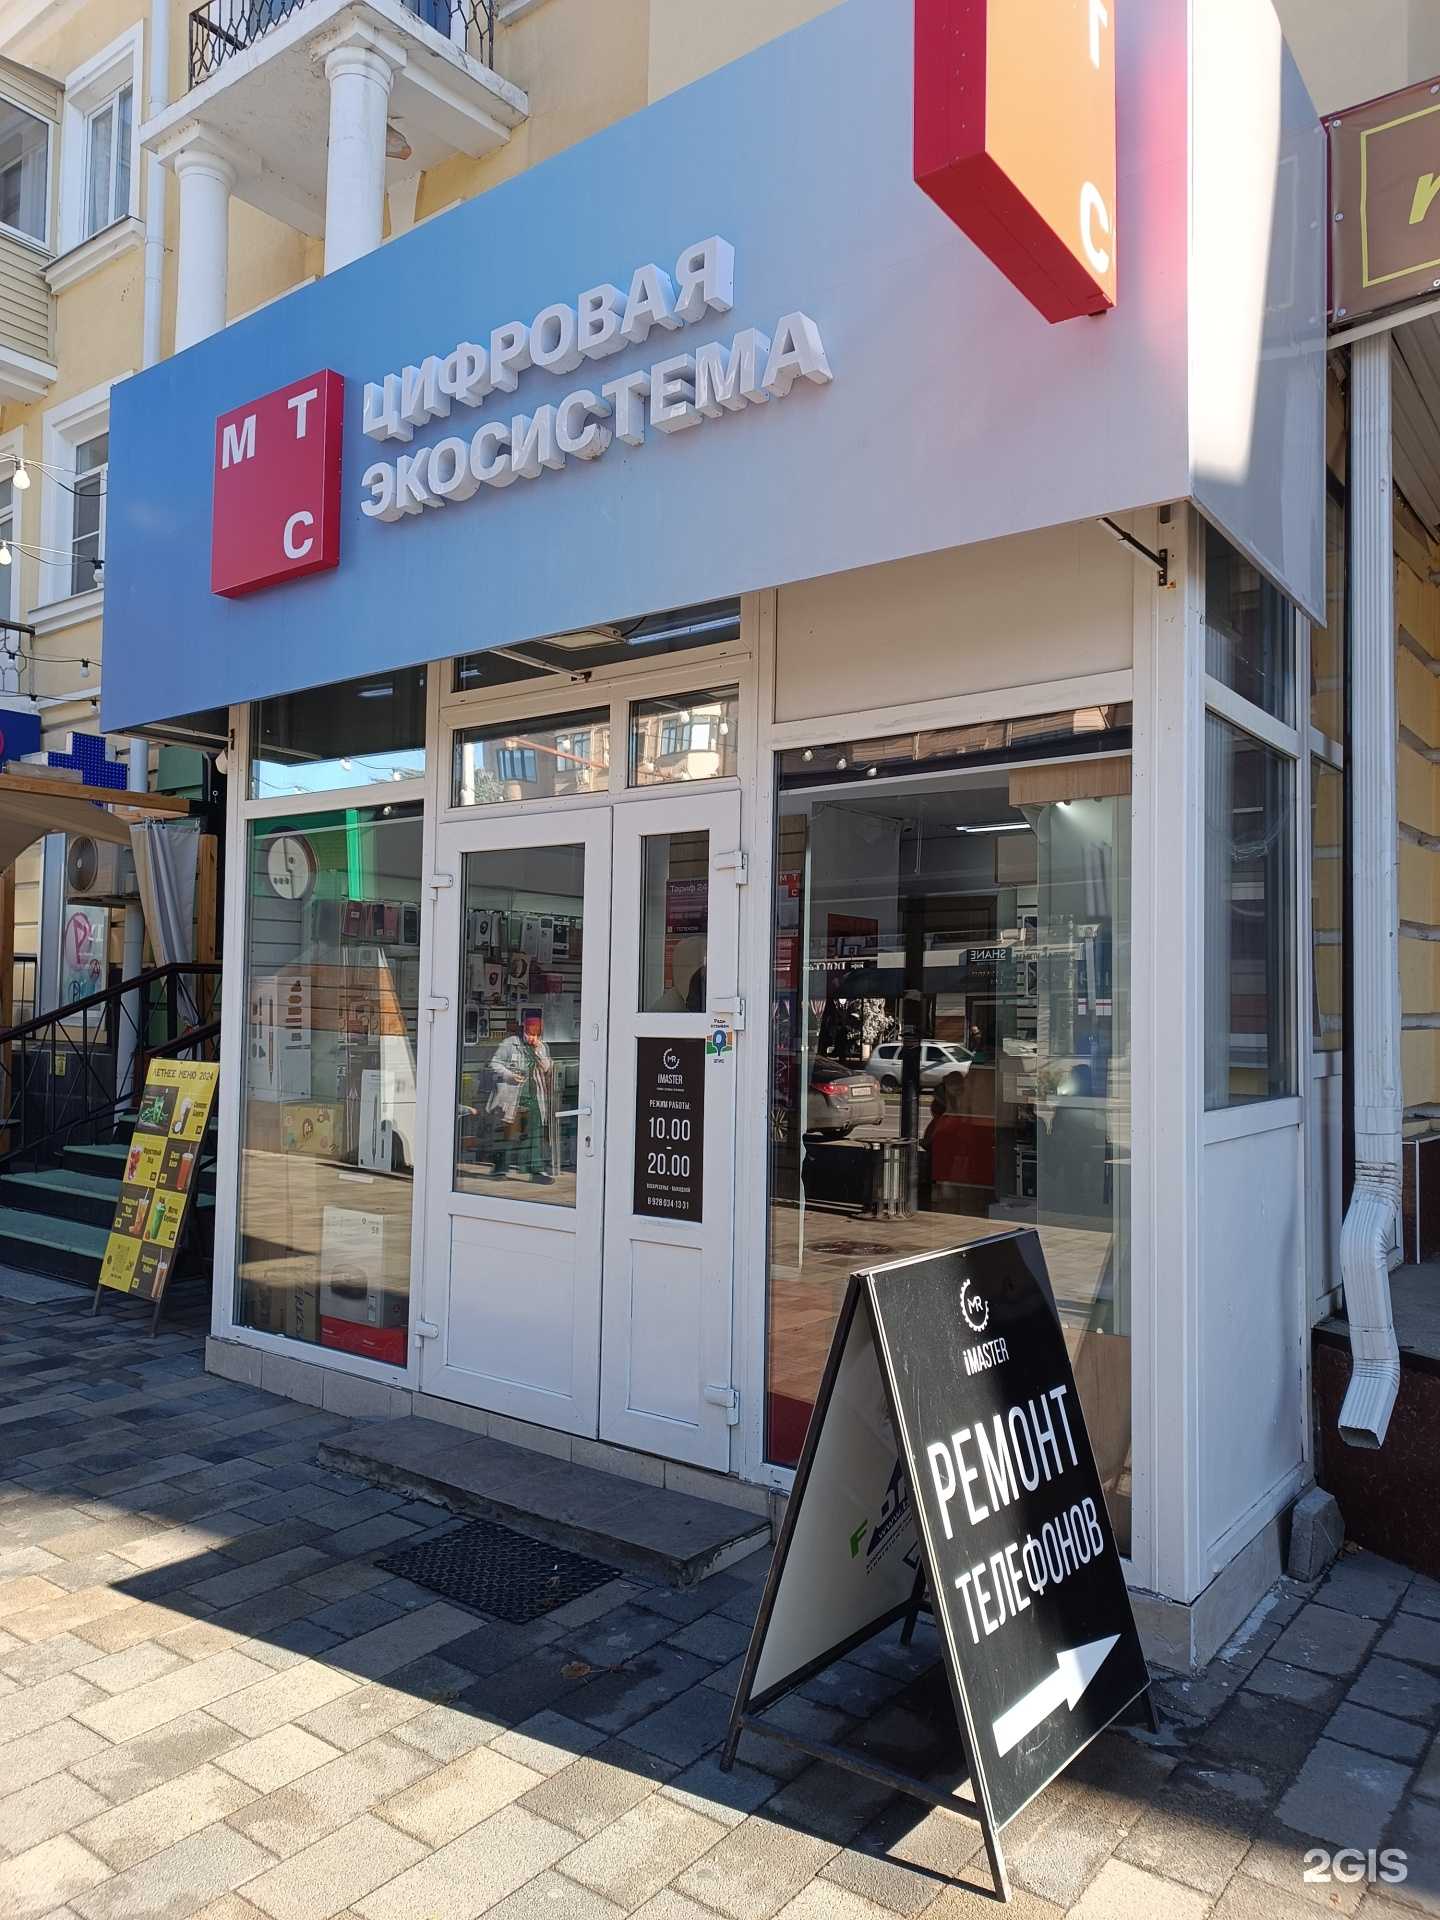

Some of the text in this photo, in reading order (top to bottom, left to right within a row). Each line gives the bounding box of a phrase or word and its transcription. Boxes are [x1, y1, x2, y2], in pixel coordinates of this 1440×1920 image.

[362, 234, 736, 443] ЦИФРОВАЯ
[360, 310, 834, 524] ЭКОСИСТЕМА
[178, 1069, 197, 1080] МЕНЮ
[199, 1070, 214, 1081] 2024
[649, 1099, 668, 1109] РЕЖИМ
[648, 1116, 691, 1142] 10.00
[647, 1152, 690, 1178] 20.00
[962, 1337, 1010, 1377] iMASTER
[926, 1383, 1079, 1540] РЕМОНТ
[954, 1496, 1104, 1645] ТЕЛЕФОНОВ
